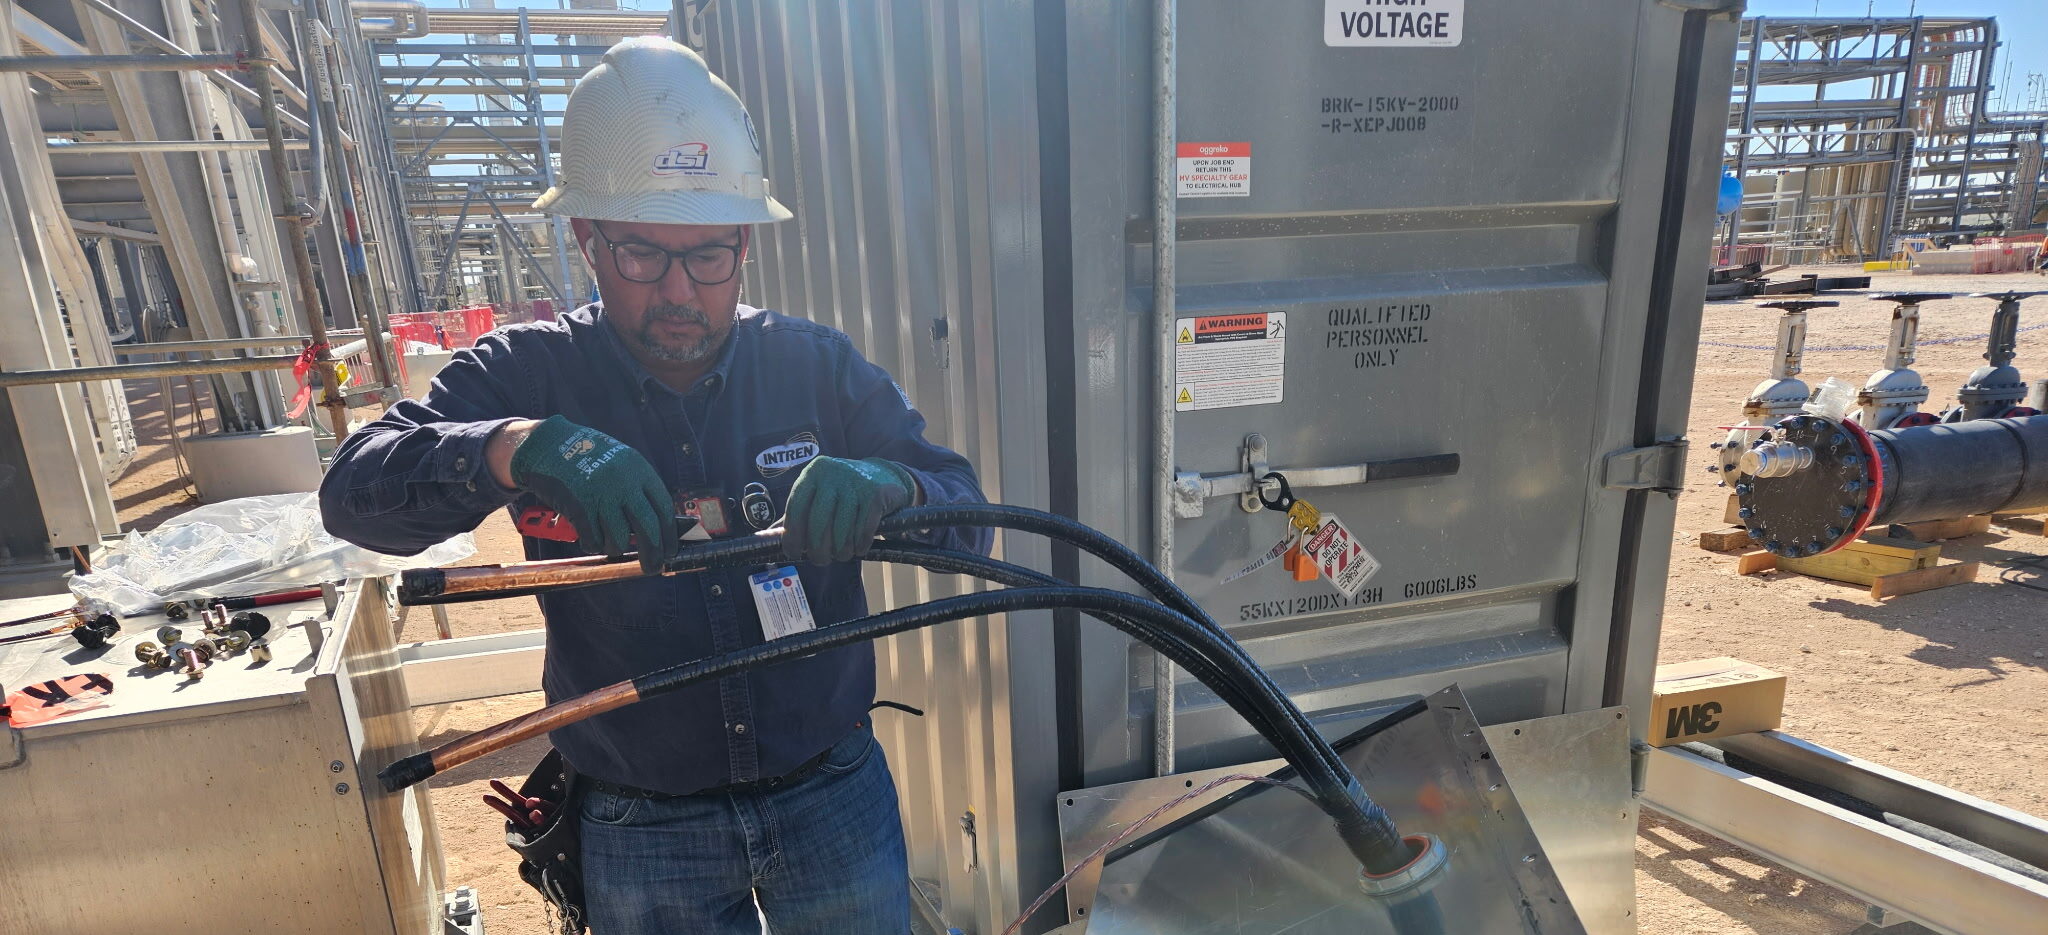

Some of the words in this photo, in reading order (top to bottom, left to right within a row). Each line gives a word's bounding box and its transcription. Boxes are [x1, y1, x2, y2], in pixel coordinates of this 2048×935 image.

[1341, 11, 1450, 38] VOLTAGE
[1321, 96, 1459, 113] BRK-15KV-2000
[654, 150, 708, 170] dsi
[1199, 145, 1228, 155] aggreko
[1229, 173, 1248, 181] GEAR
[1208, 317, 1263, 328] WARNING
[1328, 304, 1431, 326] QUALIFIED
[1327, 326, 1428, 349] PERSONNEL
[1355, 348, 1399, 368] ONLY
[763, 445, 814, 465] INTREN
[1310, 525, 1334, 550] DANGER
[1322, 549, 1332, 559] DO
[1330, 538, 1342, 550] NOT
[1325, 541, 1349, 566] OPERATE
[1666, 702, 1722, 738] 3M
